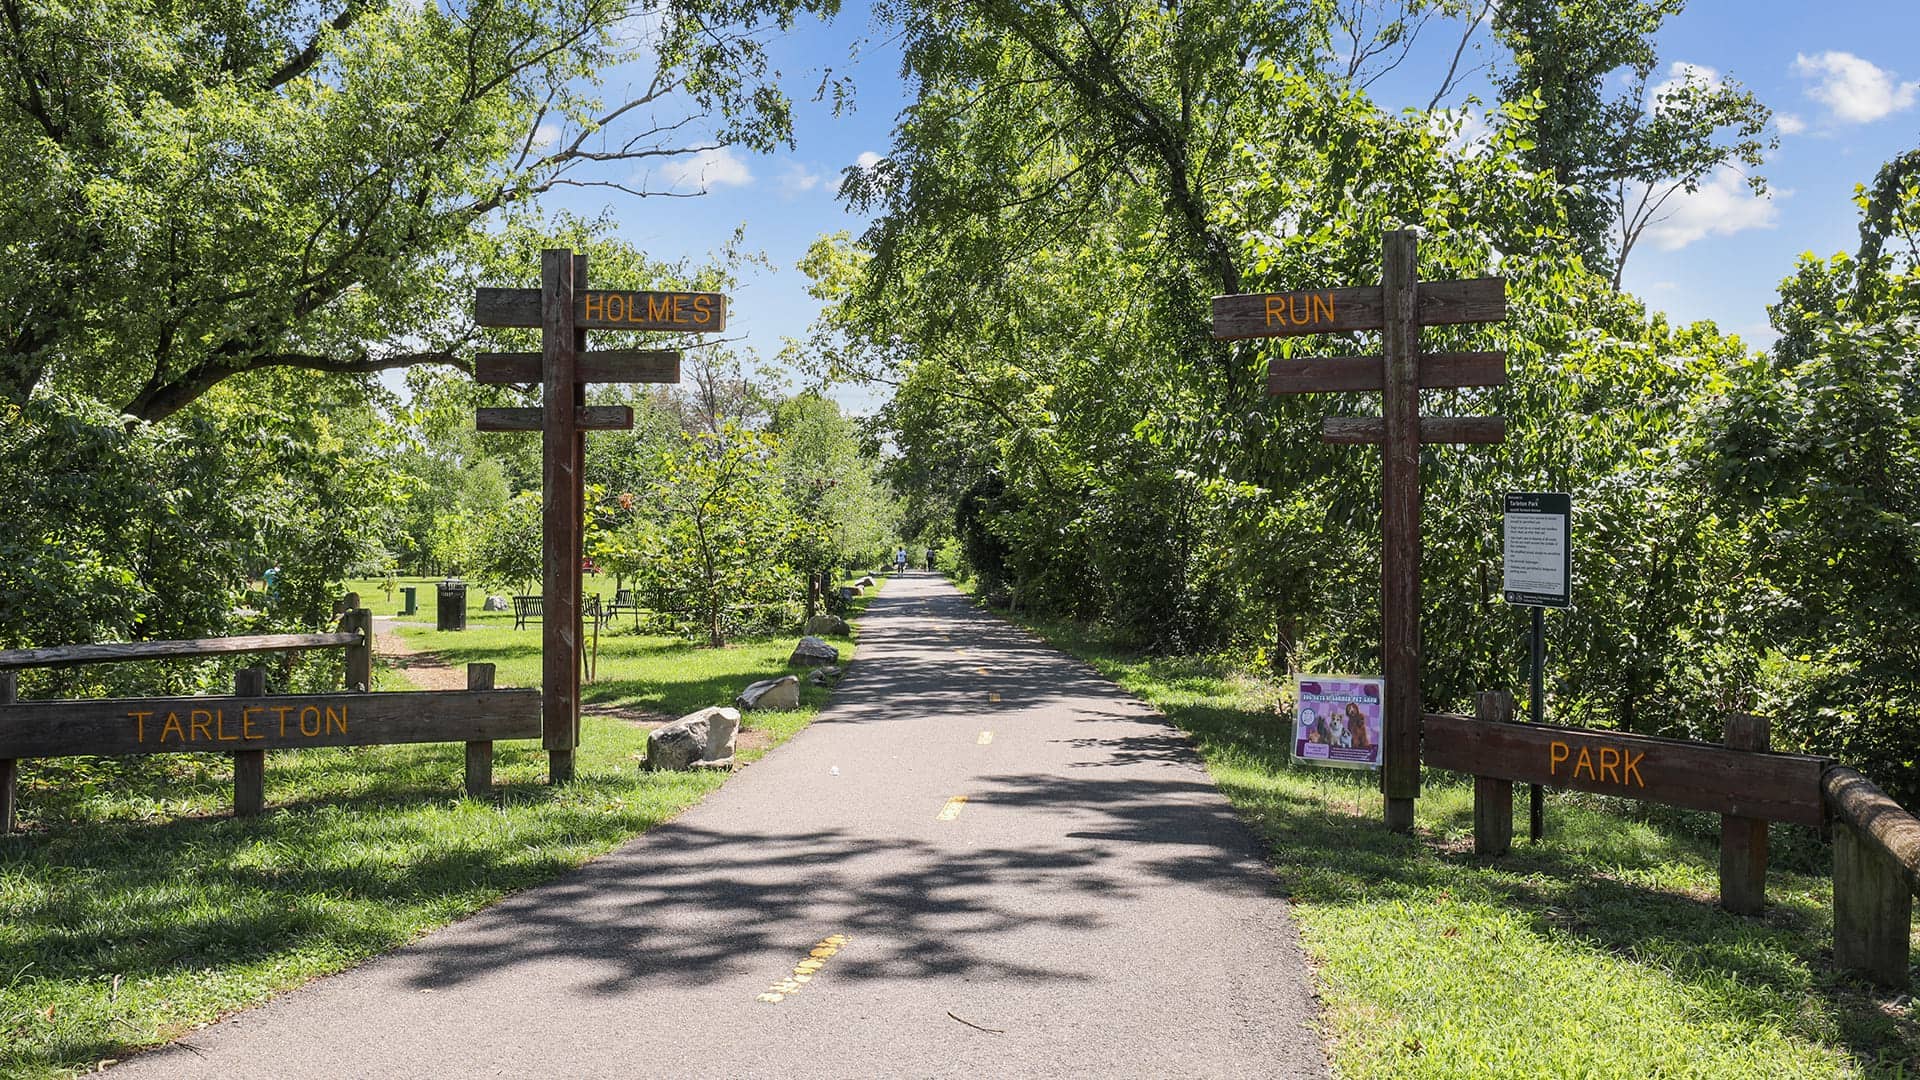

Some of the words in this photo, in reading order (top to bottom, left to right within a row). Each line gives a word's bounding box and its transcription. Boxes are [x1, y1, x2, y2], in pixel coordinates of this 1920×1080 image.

[585, 293, 712, 324] HOLMES
[1265, 293, 1335, 327] RUN
[128, 704, 348, 743] TARLETON
[1550, 741, 1646, 788] PARK
